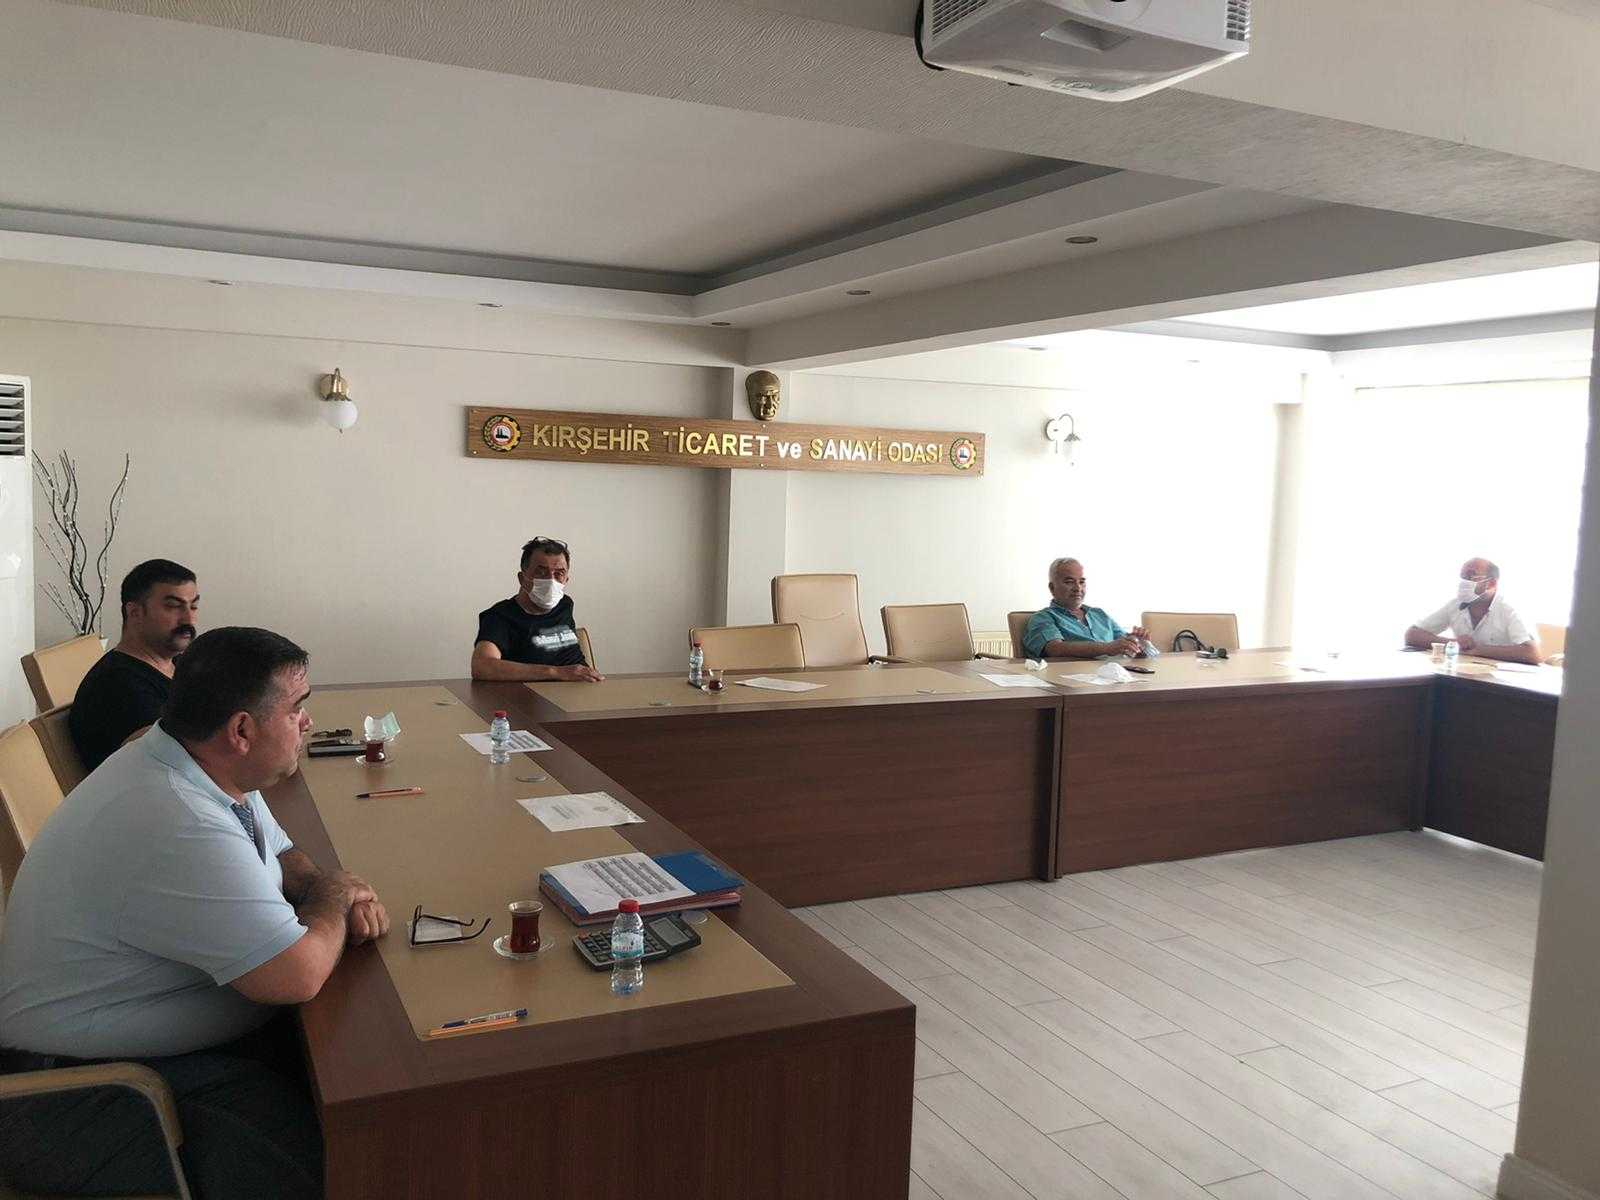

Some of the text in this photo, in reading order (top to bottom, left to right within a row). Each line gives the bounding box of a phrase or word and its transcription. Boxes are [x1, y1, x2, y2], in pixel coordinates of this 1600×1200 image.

[533, 423, 943, 463] KIRŞEHİR TİCARET ve SANAYİ ODASI
